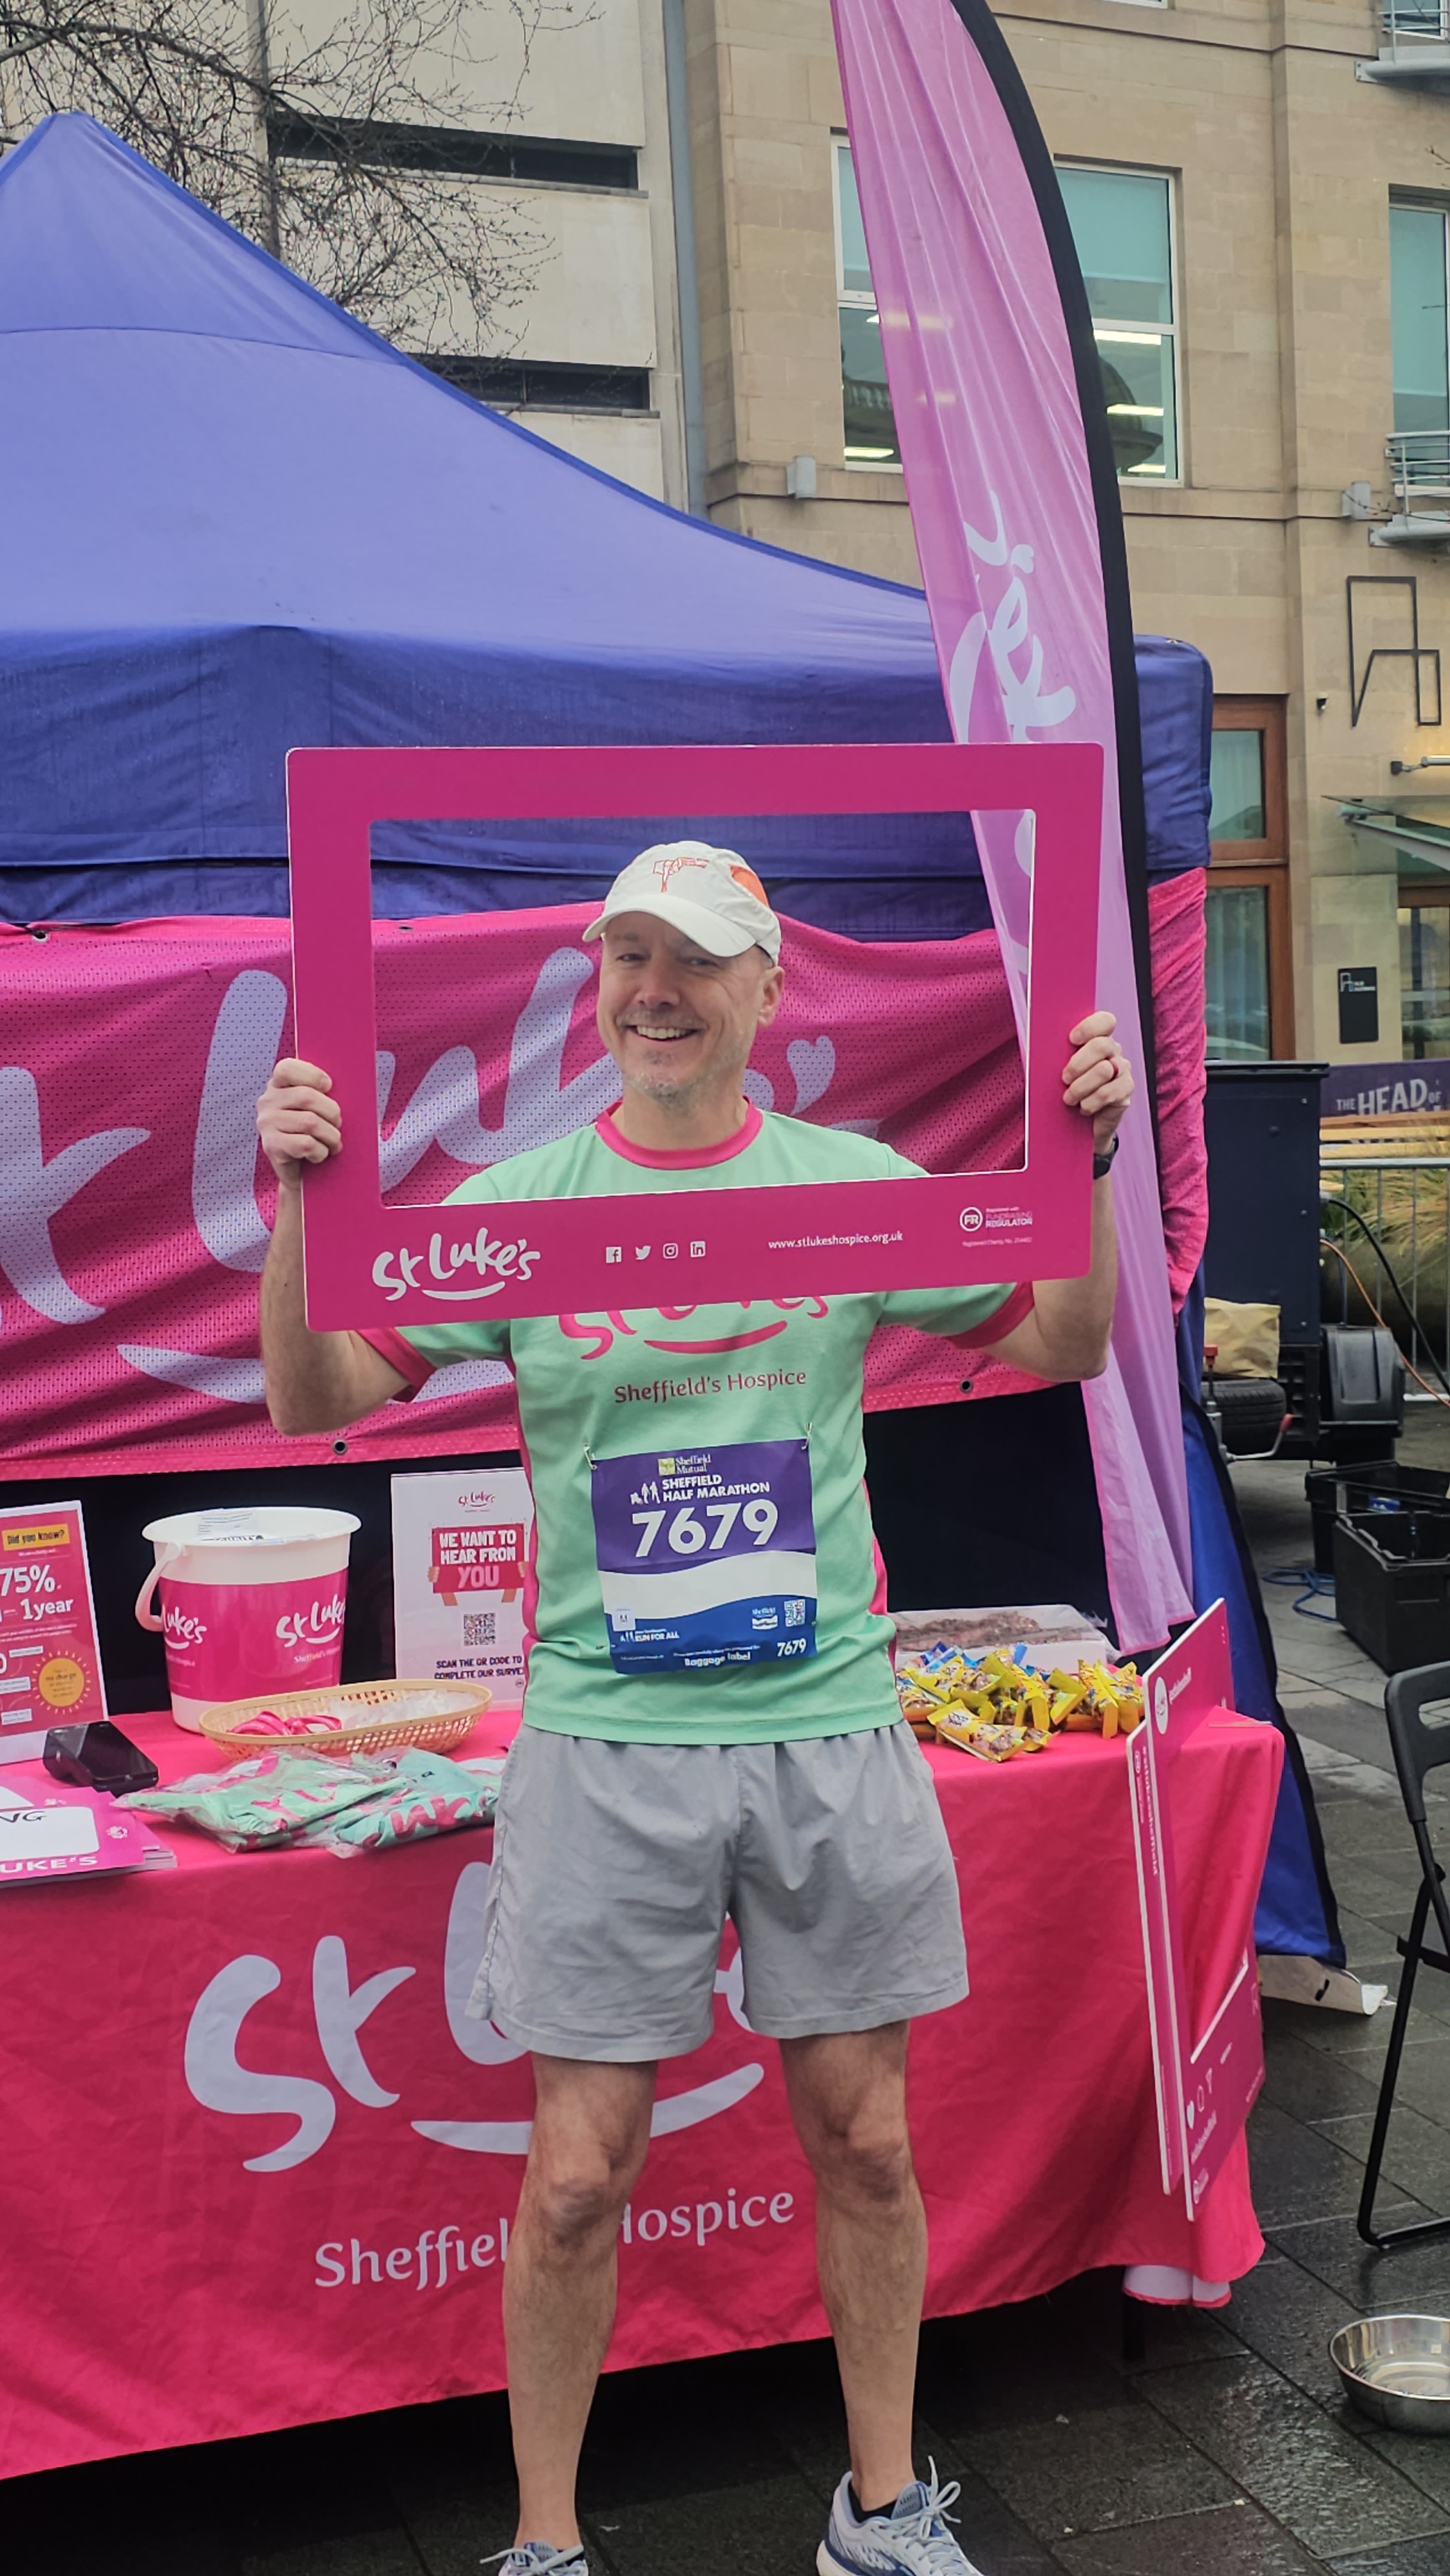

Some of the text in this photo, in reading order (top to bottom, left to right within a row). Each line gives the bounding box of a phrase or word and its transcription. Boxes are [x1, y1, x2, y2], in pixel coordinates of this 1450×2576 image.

[1336, 1098, 1356, 1111] THE
[1357, 1078, 1428, 1116] HEAD
[1429, 1091, 1442, 1104] OF
[0, 1066, 152, 1325] t
[985, 1218, 1033, 1228] REGULATOR
[768, 1231, 903, 1249] www.stlukeshospice.org.uk
[372, 1227, 541, 1302] St Luke's
[614, 1368, 807, 1404] Sheffield's Hospice
[675, 1453, 712, 1466] Sheffield
[676, 1463, 708, 1475] Mutual
[662, 1474, 722, 1491] SHEFFIELD
[663, 1481, 771, 1502] HALF MARATHON
[632, 1499, 779, 1558] 7679
[439, 1529, 517, 1549] WE WANT TO
[440, 1546, 516, 1565] HEAR FROM
[0, 1564, 56, 1596] 75%
[457, 1565, 500, 1589] YOU
[276, 1613, 308, 1648] St
[727, 1651, 751, 1661] label
[777, 1638, 807, 1657] 7679
[436, 1655, 523, 1669] SCAN THE QR CODE TO
[434, 1667, 524, 1680] COMPLETE OUR SURVE
[184, 1935, 416, 2172] St
[314, 2217, 509, 2291] Sheffiel
